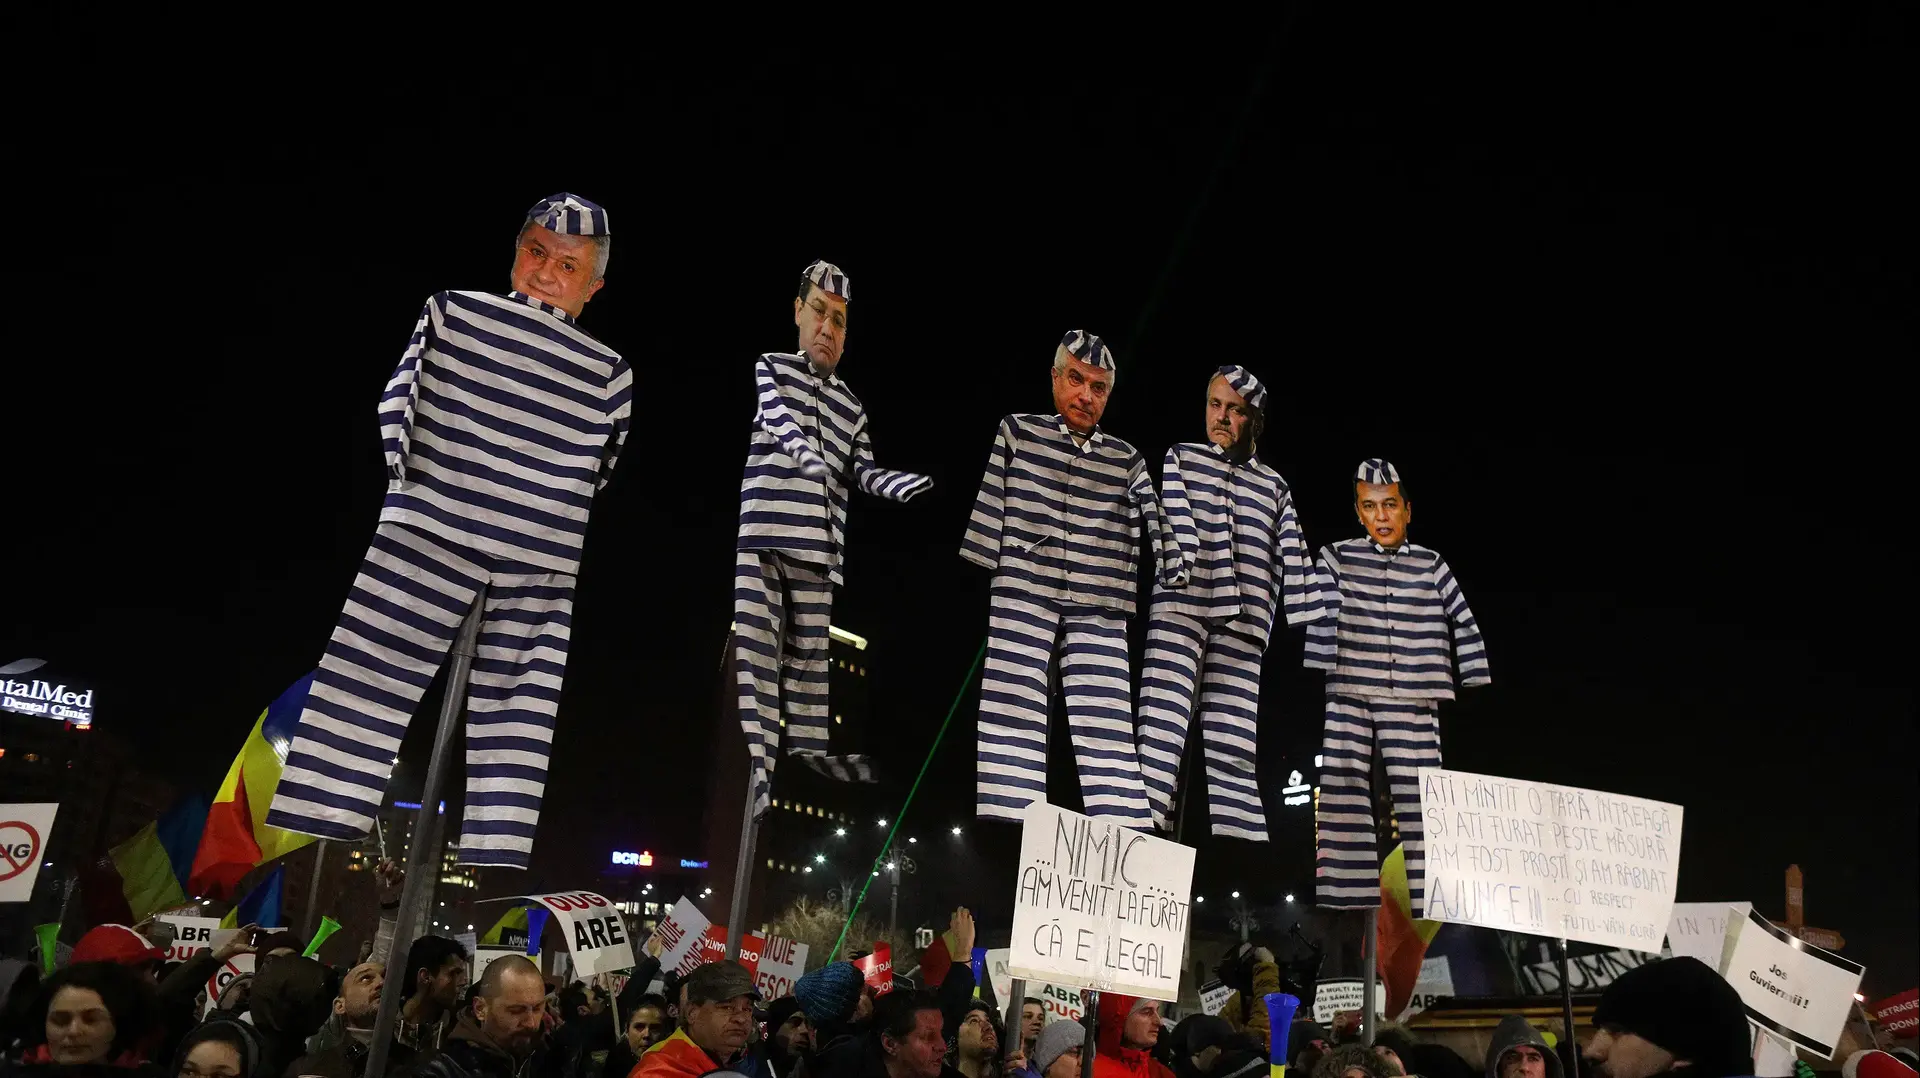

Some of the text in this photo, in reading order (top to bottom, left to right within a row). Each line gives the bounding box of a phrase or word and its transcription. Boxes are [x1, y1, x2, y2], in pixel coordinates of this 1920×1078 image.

[2, 696, 90, 720] Dental Clinic
[1527, 788, 1542, 815] O
[1488, 815, 1544, 848] FURAT
[1551, 821, 1602, 852] PESTE
[612, 851, 640, 866] BCR
[1429, 843, 1460, 871] AM
[1466, 845, 1512, 875] FOST
[1591, 859, 1613, 885] AM
[542, 893, 608, 911] OUG
[1020, 866, 1189, 933] AM VENIT LA FURAT
[1590, 889, 1636, 909] RESPECT
[573, 915, 626, 952] ARE
[1033, 918, 1172, 980] CĂ E LEGAL
[1769, 964, 1788, 981] Jos
